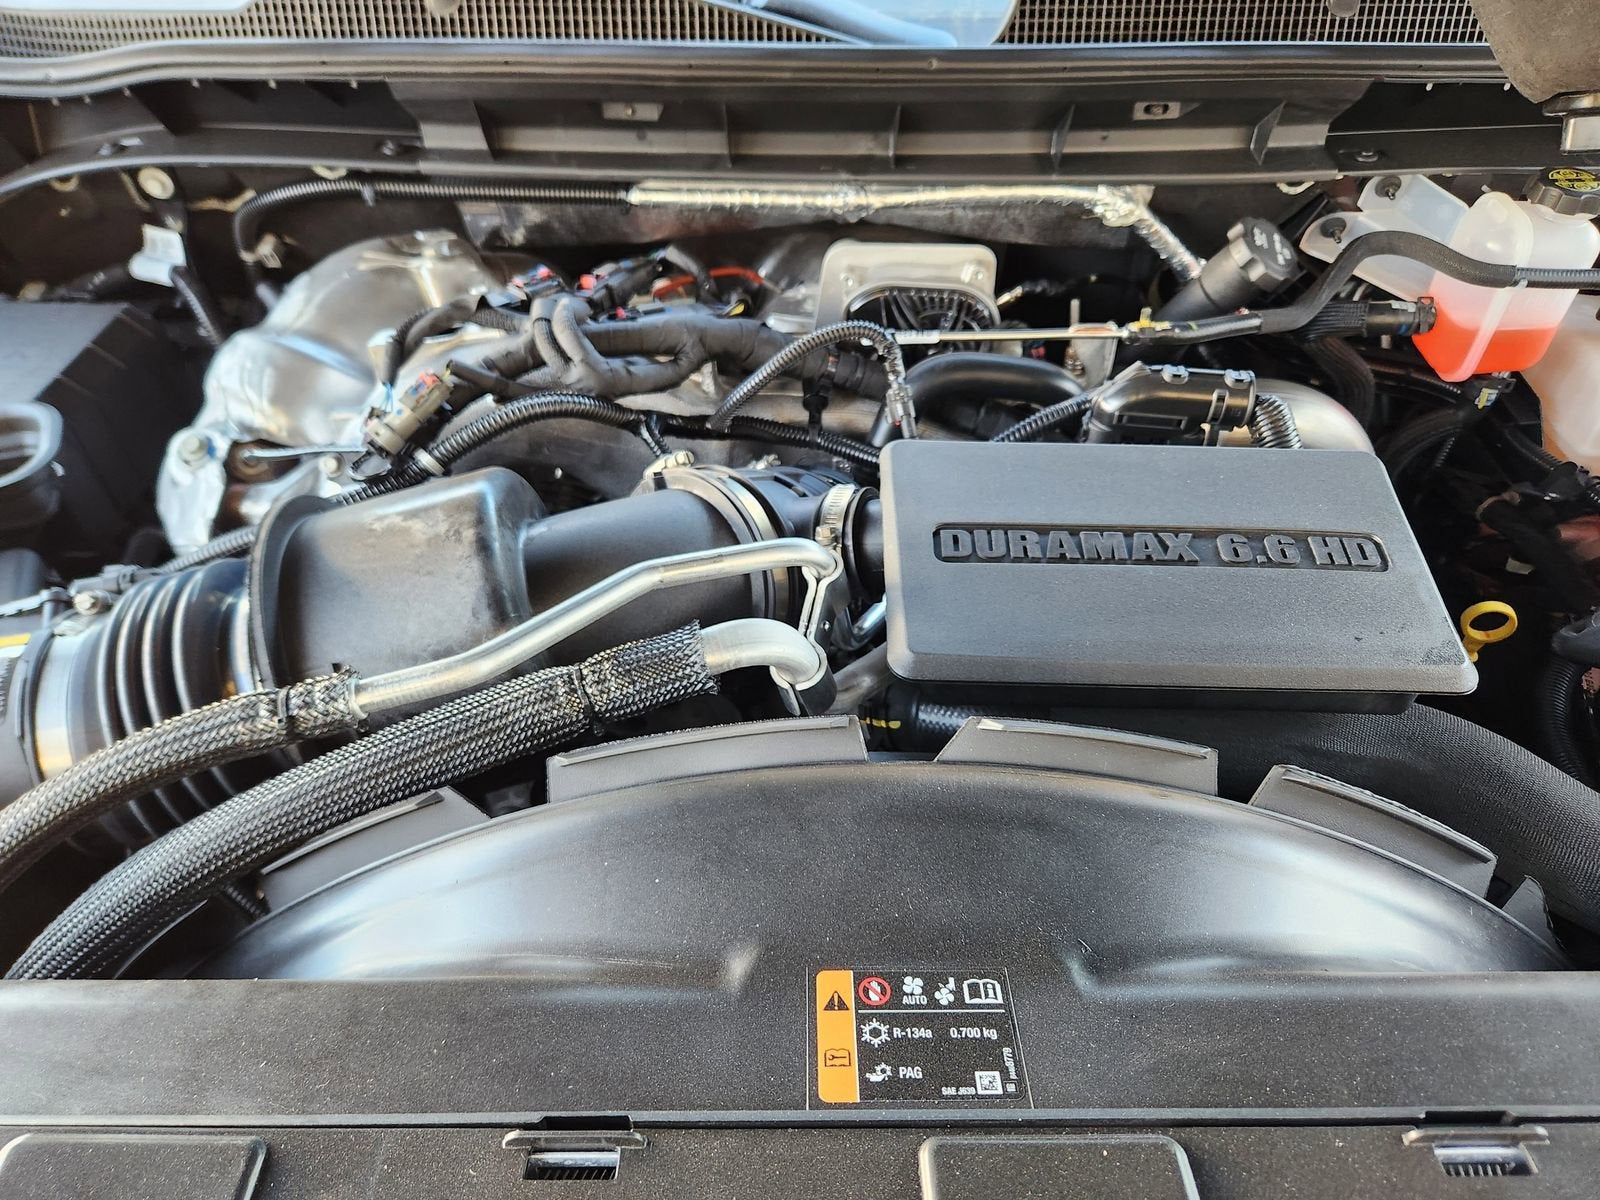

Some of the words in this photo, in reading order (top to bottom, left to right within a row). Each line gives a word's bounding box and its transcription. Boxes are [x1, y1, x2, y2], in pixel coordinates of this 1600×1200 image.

[940, 529, 1199, 562] DURAMAX
[1216, 533, 1301, 565] 6.6
[1309, 535, 1384, 567] HD
[902, 995, 928, 1006] AUTO
[892, 1027, 933, 1039] R-134a
[982, 1027, 998, 1040] kg
[898, 1066, 923, 1080] PAG
[941, 1086, 957, 1095] SAE
